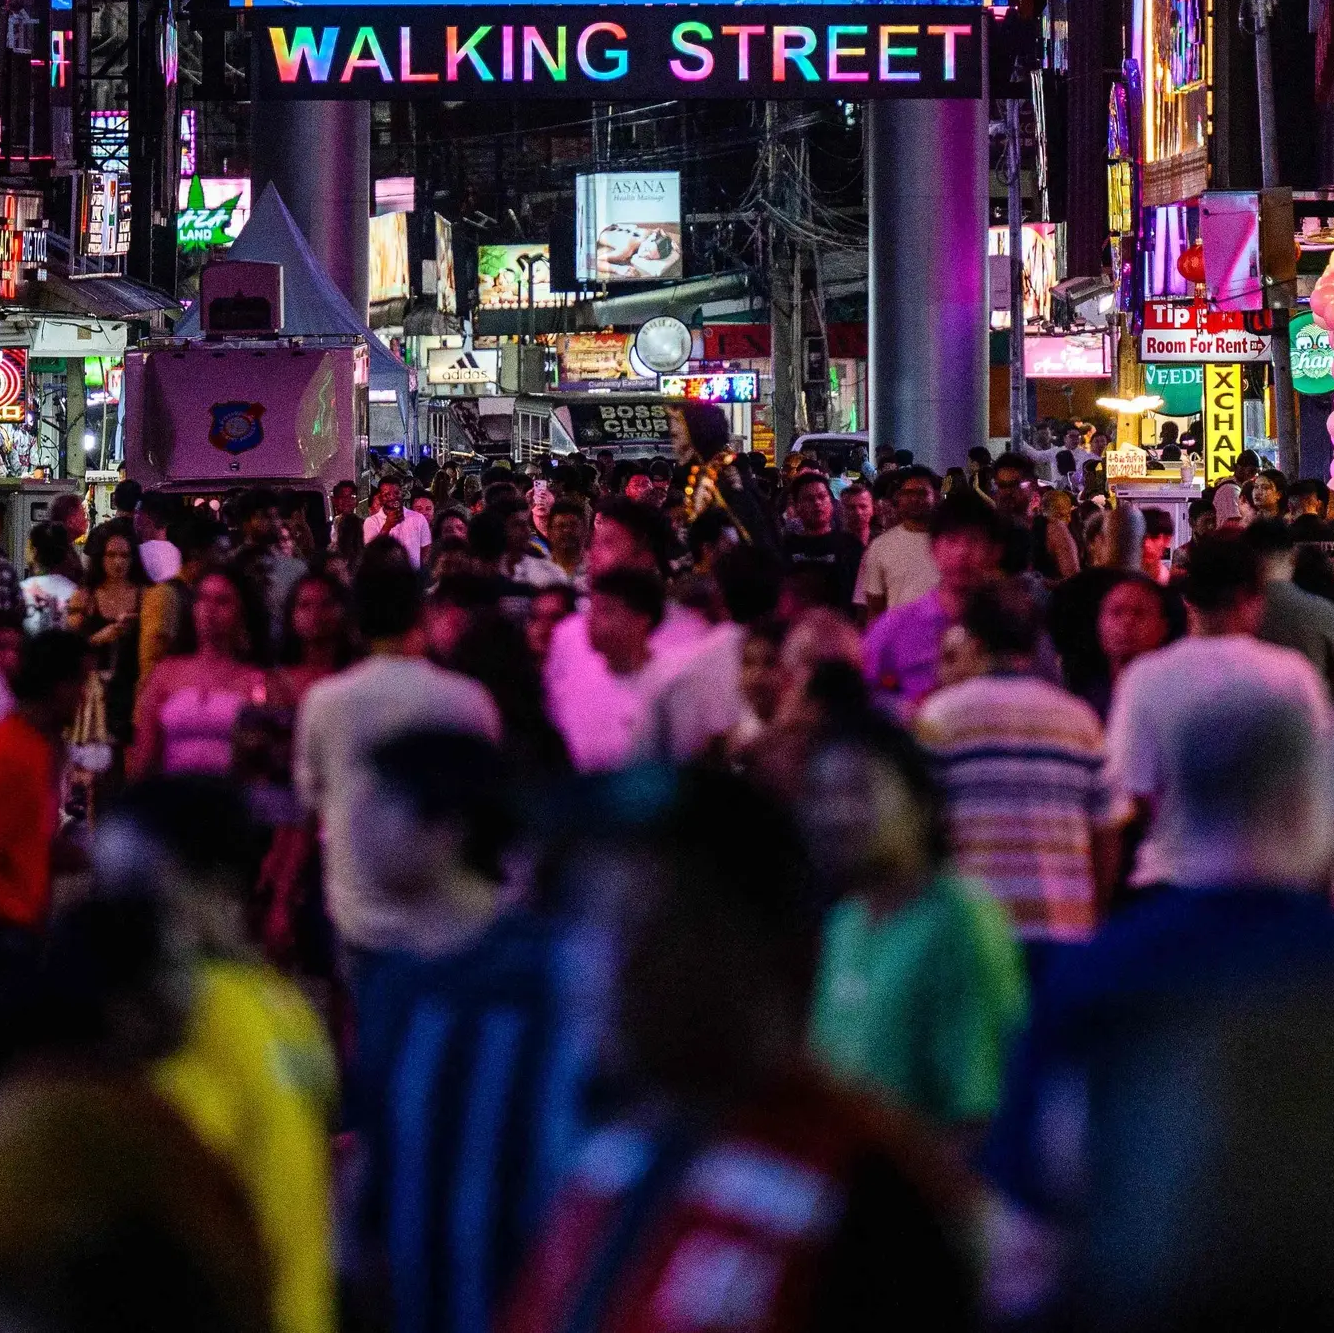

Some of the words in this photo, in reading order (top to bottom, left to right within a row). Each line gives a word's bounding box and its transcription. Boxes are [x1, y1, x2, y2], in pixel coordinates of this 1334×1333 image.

[268, 20, 630, 83] WALKING
[669, 20, 973, 83] STREET
[611, 180, 666, 194] ASANA
[177, 208, 229, 229] AZA
[179, 228, 213, 241] LAND
[1153, 304, 1191, 328] Tip
[1147, 337, 1186, 353] Room
[1190, 337, 1213, 353] For
[1216, 337, 1248, 353] Rent
[1290, 345, 1333, 370] Chan
[442, 369, 489, 380] adidas
[588, 380, 622, 389] Currency
[599, 405, 666, 420] BOSS
[604, 418, 669, 433] CLUB
